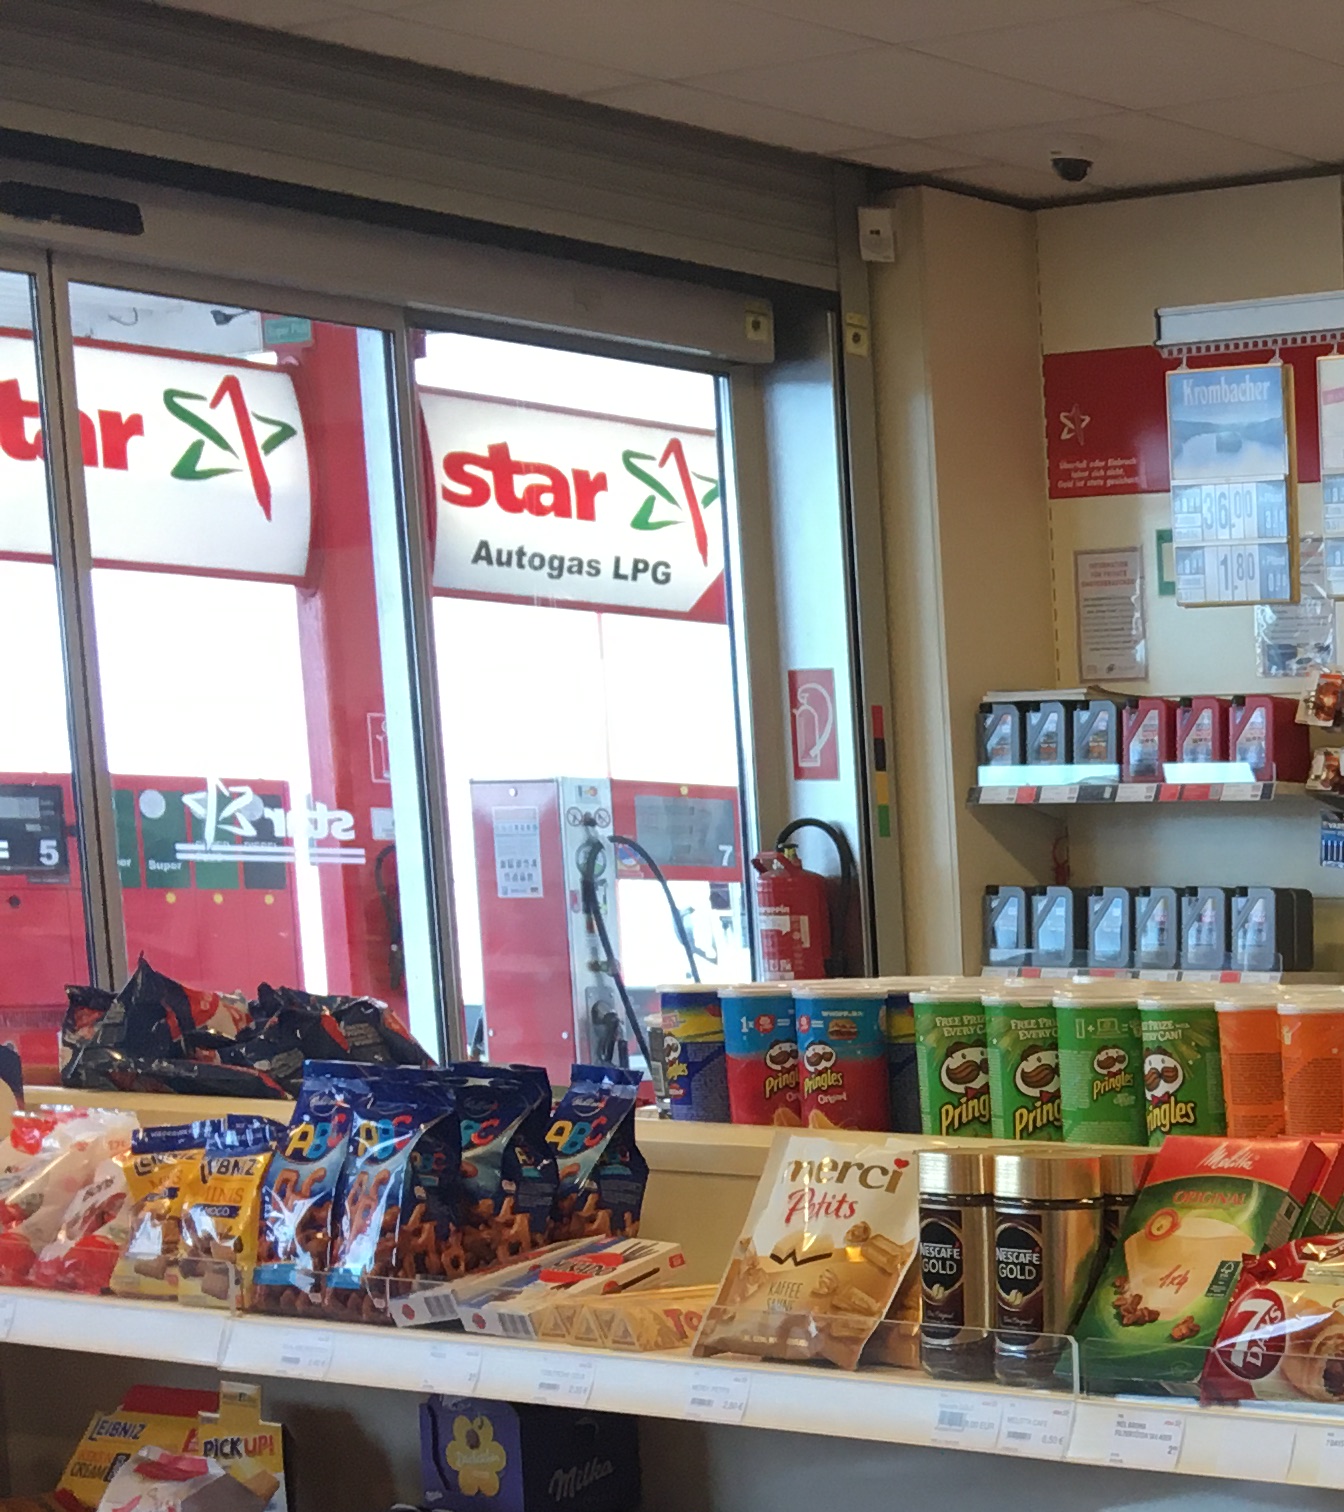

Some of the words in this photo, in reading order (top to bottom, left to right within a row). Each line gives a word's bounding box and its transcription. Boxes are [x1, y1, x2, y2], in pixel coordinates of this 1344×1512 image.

[1182, 375, 1271, 406] Krombacher
[441, 441, 608, 521] star
[471, 539, 601, 580] Autogas
[612, 555, 672, 585] LPG
[802, 1069, 843, 1098] Pringles
[287, 1114, 347, 1162] ABC
[358, 1115, 414, 1161] ABC
[1198, 1142, 1259, 1171] Melitta
[781, 1157, 909, 1195] merci
[784, 1187, 859, 1226] Petits
[1173, 1189, 1247, 1206] ORIGINAL
[922, 1258, 957, 1275] GOLD
[998, 1263, 1037, 1281] GOLD
[768, 1281, 804, 1297] KAFFEE
[202, 1437, 241, 1459] PICK
[242, 1432, 276, 1459] UP!
